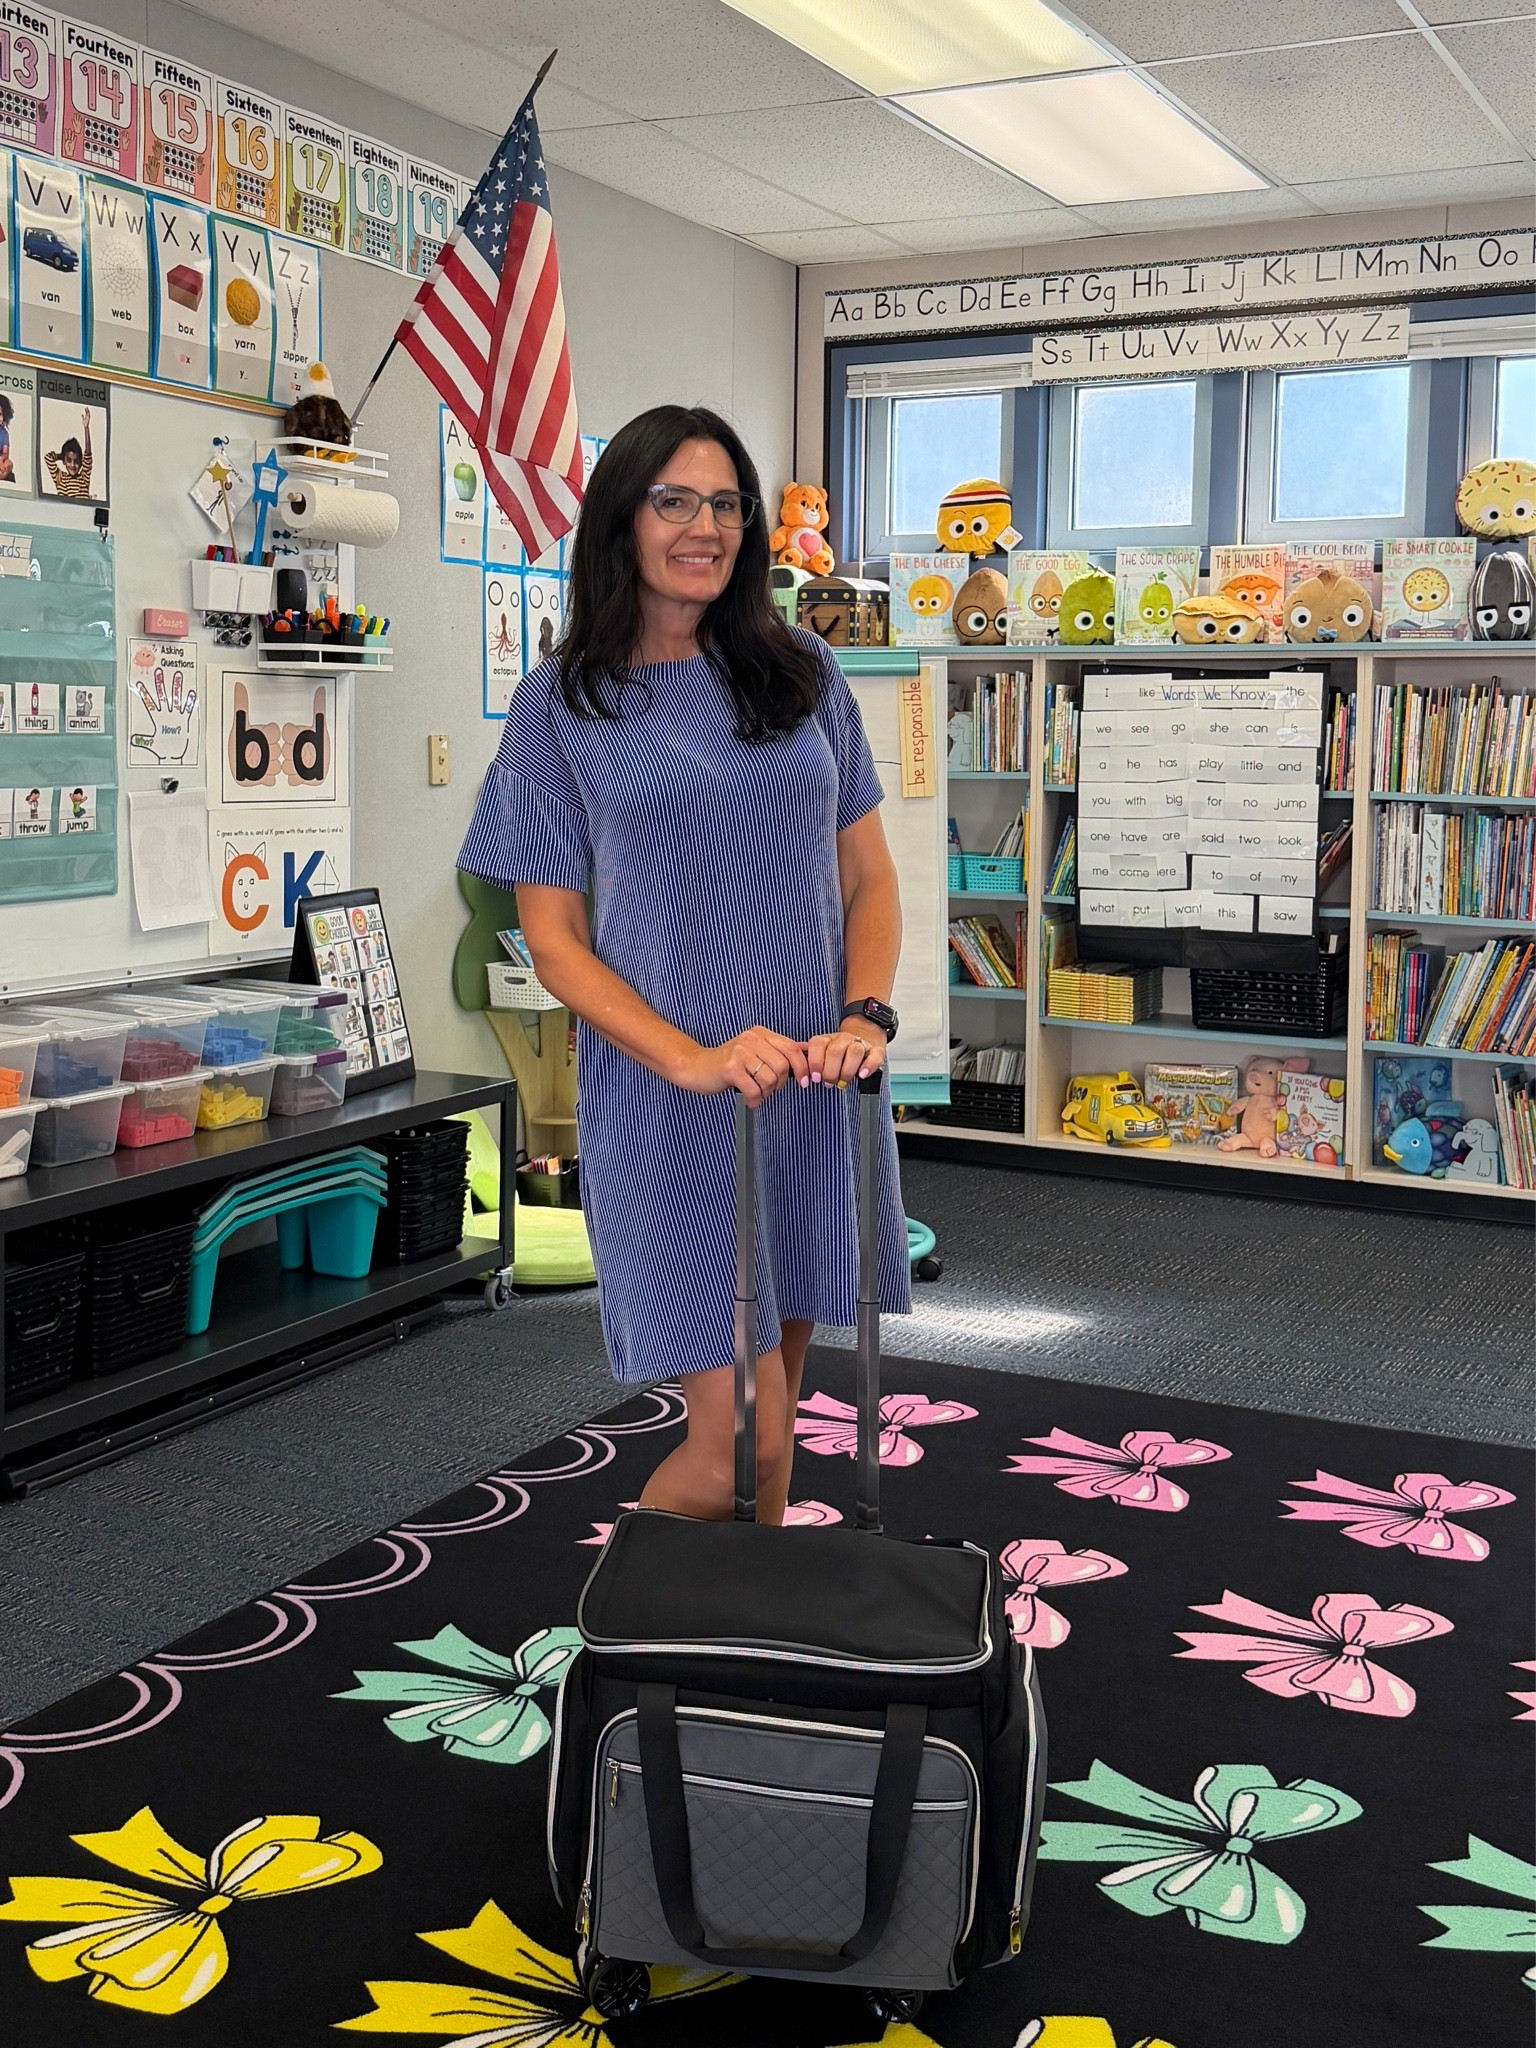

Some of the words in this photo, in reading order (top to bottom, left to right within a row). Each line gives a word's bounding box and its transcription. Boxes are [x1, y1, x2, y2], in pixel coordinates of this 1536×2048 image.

[0, 2, 48, 36] irteen
[68, 28, 134, 68] Fourteen
[0, 28, 38, 89] 13
[155, 61, 201, 92] Fifteen
[79, 60, 124, 120] 14
[226, 90, 272, 122] Sixteen
[158, 88, 198, 144] 15
[288, 118, 342, 151] Seventeen
[232, 117, 268, 170] 16
[353, 141, 400, 172] Eighteen
[300, 144, 334, 192] 17
[24, 170, 46, 206] V
[410, 165, 456, 196] Nineteen
[362, 168, 393, 218] 18
[92, 191, 118, 228] W
[418, 191, 448, 240] 19
[160, 212, 180, 246] X
[222, 230, 238, 262] Y
[278, 248, 292, 279] Z
[830, 297, 863, 323] Aa
[874, 294, 906, 319] Bb
[917, 289, 948, 316] Cc
[960, 284, 991, 313] Dd
[1000, 282, 1031, 309] Ee
[1042, 277, 1074, 305] Ff
[1082, 274, 1116, 314] Gg
[1133, 270, 1168, 298] Hh
[1182, 265, 1205, 294] Ii
[1221, 260, 1246, 303] Jj
[1262, 258, 1296, 286] Kk
[1316, 252, 1343, 283] Ll
[1355, 248, 1409, 279] Mm
[1419, 243, 1456, 274] Nn
[1478, 238, 1518, 268] Oo
[41, 291, 60, 303] van
[112, 308, 132, 321] web
[178, 322, 194, 336] box
[234, 338, 256, 351] yarn
[1042, 338, 1072, 365] Ss
[1083, 334, 1109, 362] Tt
[1122, 332, 1154, 360] Uu
[1164, 328, 1199, 356] Vv
[1217, 324, 1262, 353] Ww
[1270, 320, 1307, 350] Xx
[1316, 316, 1350, 358] Yy
[1361, 312, 1400, 343] Zz
[283, 350, 308, 364] zipper
[0, 374, 34, 390] cross
[40, 380, 72, 394] raise
[76, 380, 106, 400] hand
[446, 420, 462, 446] A
[455, 511, 474, 520] apple
[1294, 545, 1309, 556] THE
[1313, 544, 1338, 556] COOL
[1343, 544, 1367, 555] BEAN
[1388, 542, 1403, 554] THE
[1406, 542, 1436, 554] SMART
[1438, 542, 1474, 554] COOKIE
[894, 558, 909, 569] THE
[914, 557, 930, 568] BIG
[934, 556, 966, 568] CHEESE
[1016, 560, 1030, 570] THE
[1036, 560, 1058, 570] GOOD
[1064, 560, 1080, 570] EGG
[1120, 553, 1136, 566] THE
[1140, 552, 1164, 566] SOUR
[1166, 552, 1195, 565] GRAPE
[1216, 555, 1230, 569] THE
[1234, 552, 1270, 568] HUMBLE
[488, 580, 504, 606] O
[156, 614, 184, 628] Eraser
[160, 646, 184, 658] Asking
[160, 658, 194, 669] Questions
[493, 667, 518, 676] octopus
[1139, 687, 1156, 698] like
[1286, 686, 1305, 697] the
[1161, 685, 1196, 701] Words
[1202, 685, 1222, 701] We
[1230, 685, 1271, 701] Know
[24, 717, 48, 730] thing
[70, 718, 99, 729] animal
[162, 726, 182, 735] How?
[903, 681, 929, 764] responsible
[1096, 724, 1112, 734] we
[1131, 724, 1150, 734] see
[1171, 723, 1186, 735] go
[1210, 722, 1230, 734] she
[1246, 724, 1269, 734] can
[134, 736, 154, 746] Who?
[236, 710, 270, 782] b
[293, 712, 324, 781] d
[1099, 761, 1107, 770] a
[1126, 760, 1141, 770] he
[1158, 758, 1178, 768] has
[1199, 759, 1224, 772] play
[1240, 760, 1264, 771] little
[1278, 761, 1302, 772] and
[907, 769, 925, 787] be
[1092, 796, 1111, 806] you
[1125, 796, 1146, 806] with
[1166, 794, 1183, 806] big
[1208, 796, 1222, 806] for
[1243, 798, 1258, 808] no
[1274, 798, 1307, 811] jump
[19, 823, 47, 834] throw
[66, 820, 89, 834] jump
[1090, 833, 1110, 842] one
[1120, 832, 1148, 842] have
[1162, 832, 1181, 841] are
[1202, 833, 1225, 844] said
[1239, 835, 1261, 845] two
[1278, 834, 1302, 846] look
[238, 878, 244, 886] a
[1092, 868, 1109, 876] me
[1119, 868, 1150, 878] come
[1212, 870, 1224, 881] to
[1250, 871, 1262, 882] of
[1280, 874, 1298, 885] my
[222, 854, 270, 932] C
[284, 850, 325, 928] K
[1090, 904, 1115, 914] what
[1132, 905, 1150, 916] put
[1218, 908, 1236, 919] this
[1274, 912, 1298, 921] saw
[330, 916, 344, 927] GOOD
[330, 926, 350, 940] CHOICES
